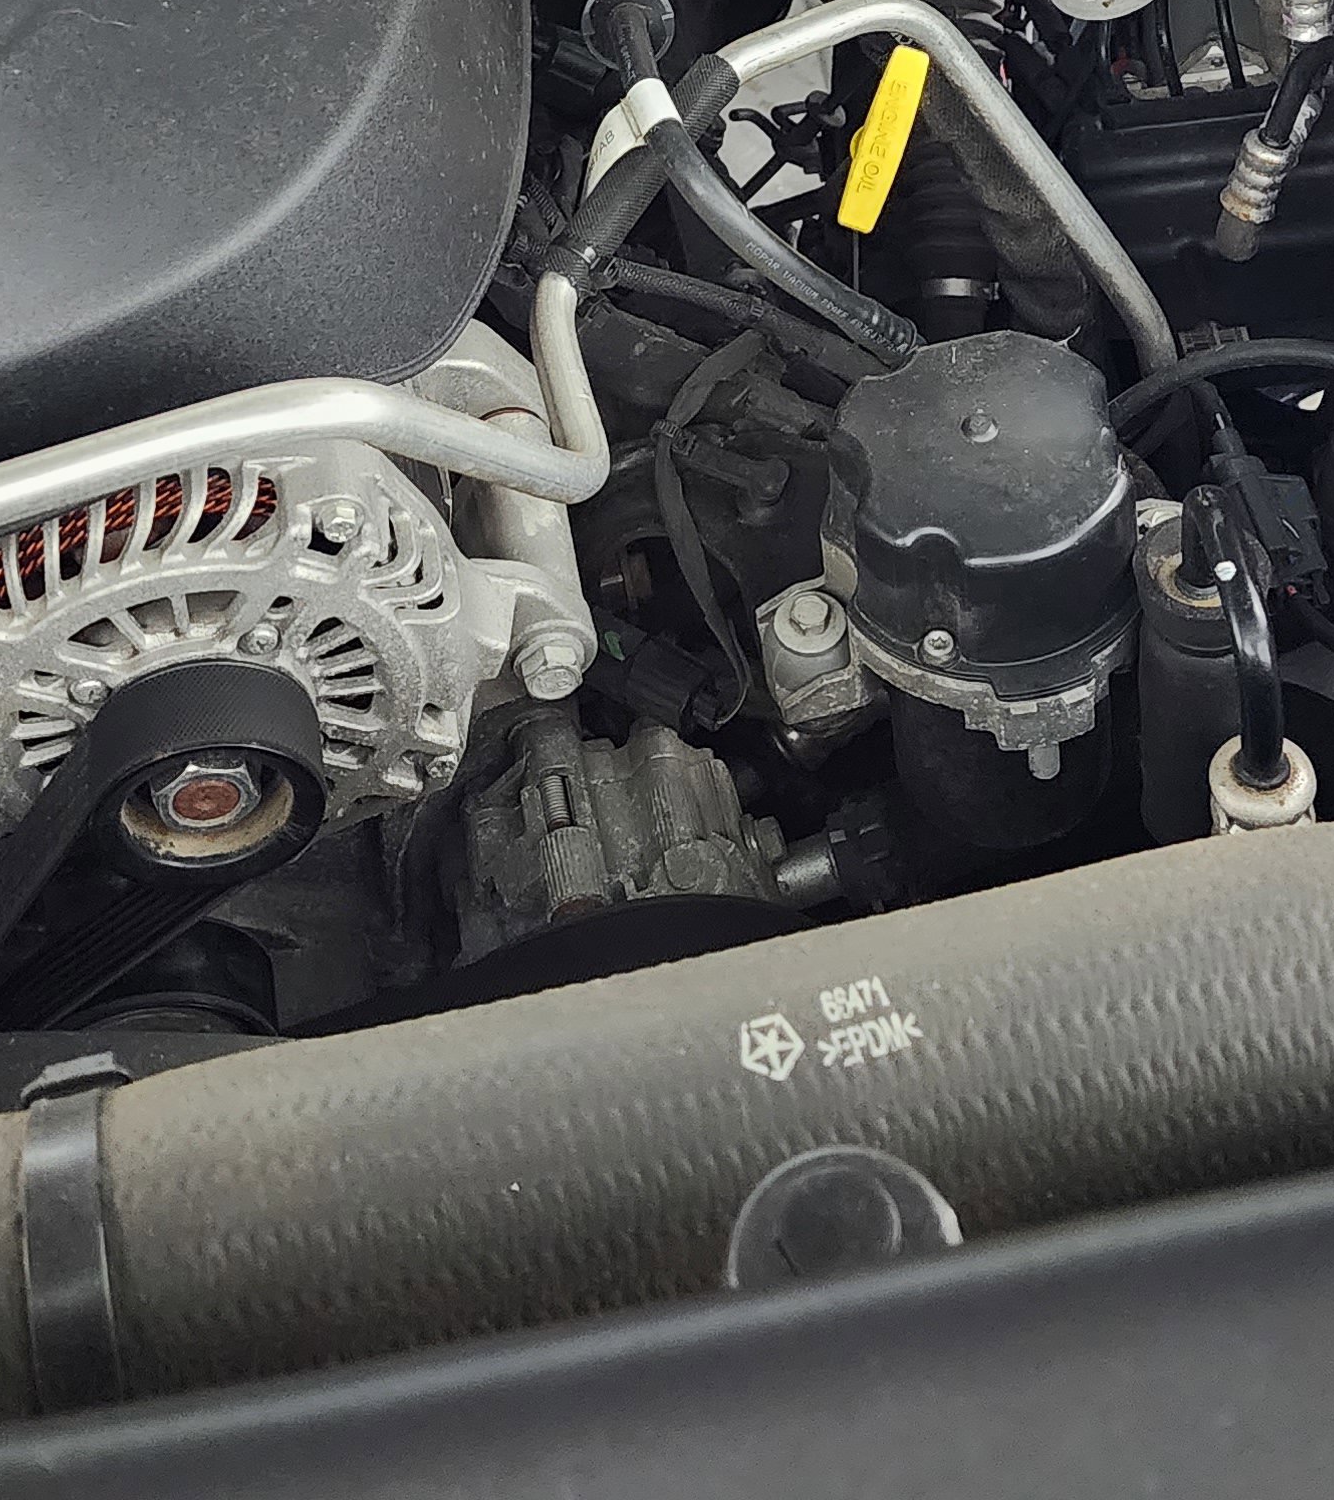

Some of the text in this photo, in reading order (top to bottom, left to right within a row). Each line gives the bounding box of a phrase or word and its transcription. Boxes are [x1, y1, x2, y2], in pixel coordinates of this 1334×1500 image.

[869, 79, 909, 159] ENGINE
[855, 160, 880, 194] OIL
[745, 241, 781, 271] MOPAR
[782, 270, 820, 300] VACUUM
